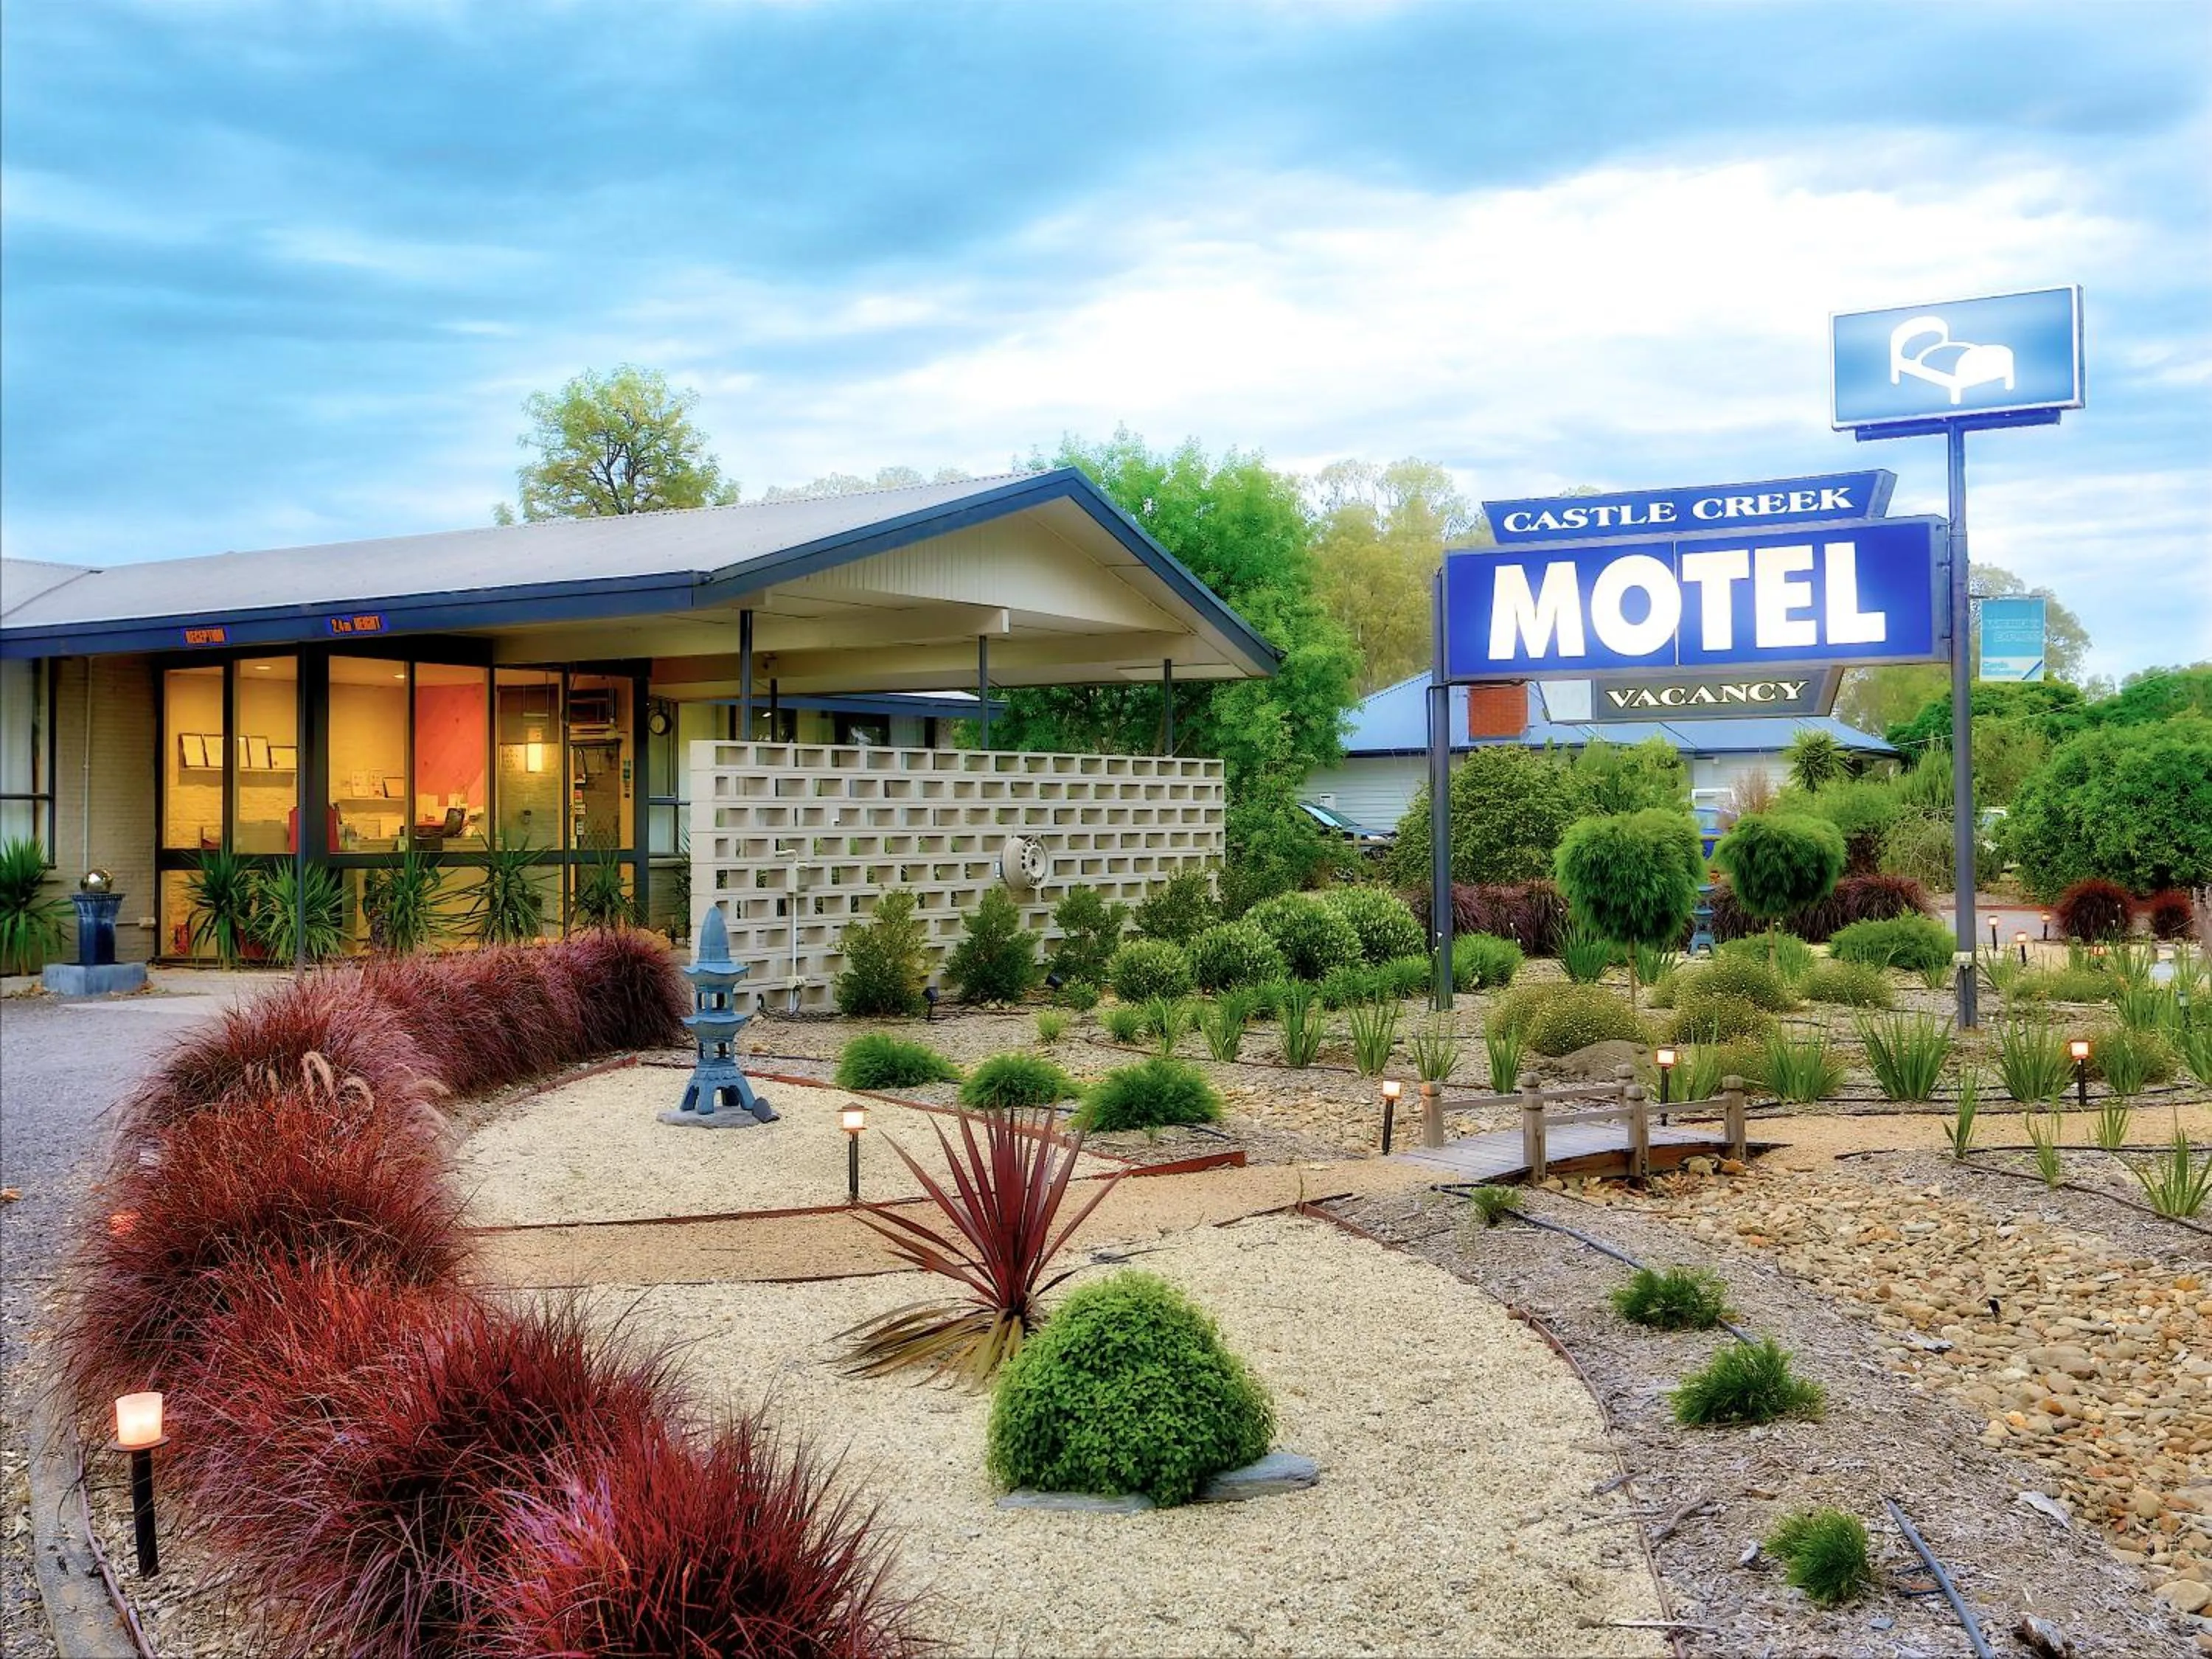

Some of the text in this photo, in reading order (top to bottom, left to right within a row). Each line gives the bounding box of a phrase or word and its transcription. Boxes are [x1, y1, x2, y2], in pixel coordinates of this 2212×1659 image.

[1503, 487, 1854, 532] CASTLE CREEK
[1488, 542, 1886, 660] MOTEL
[1606, 680, 1809, 709] VACANCY
